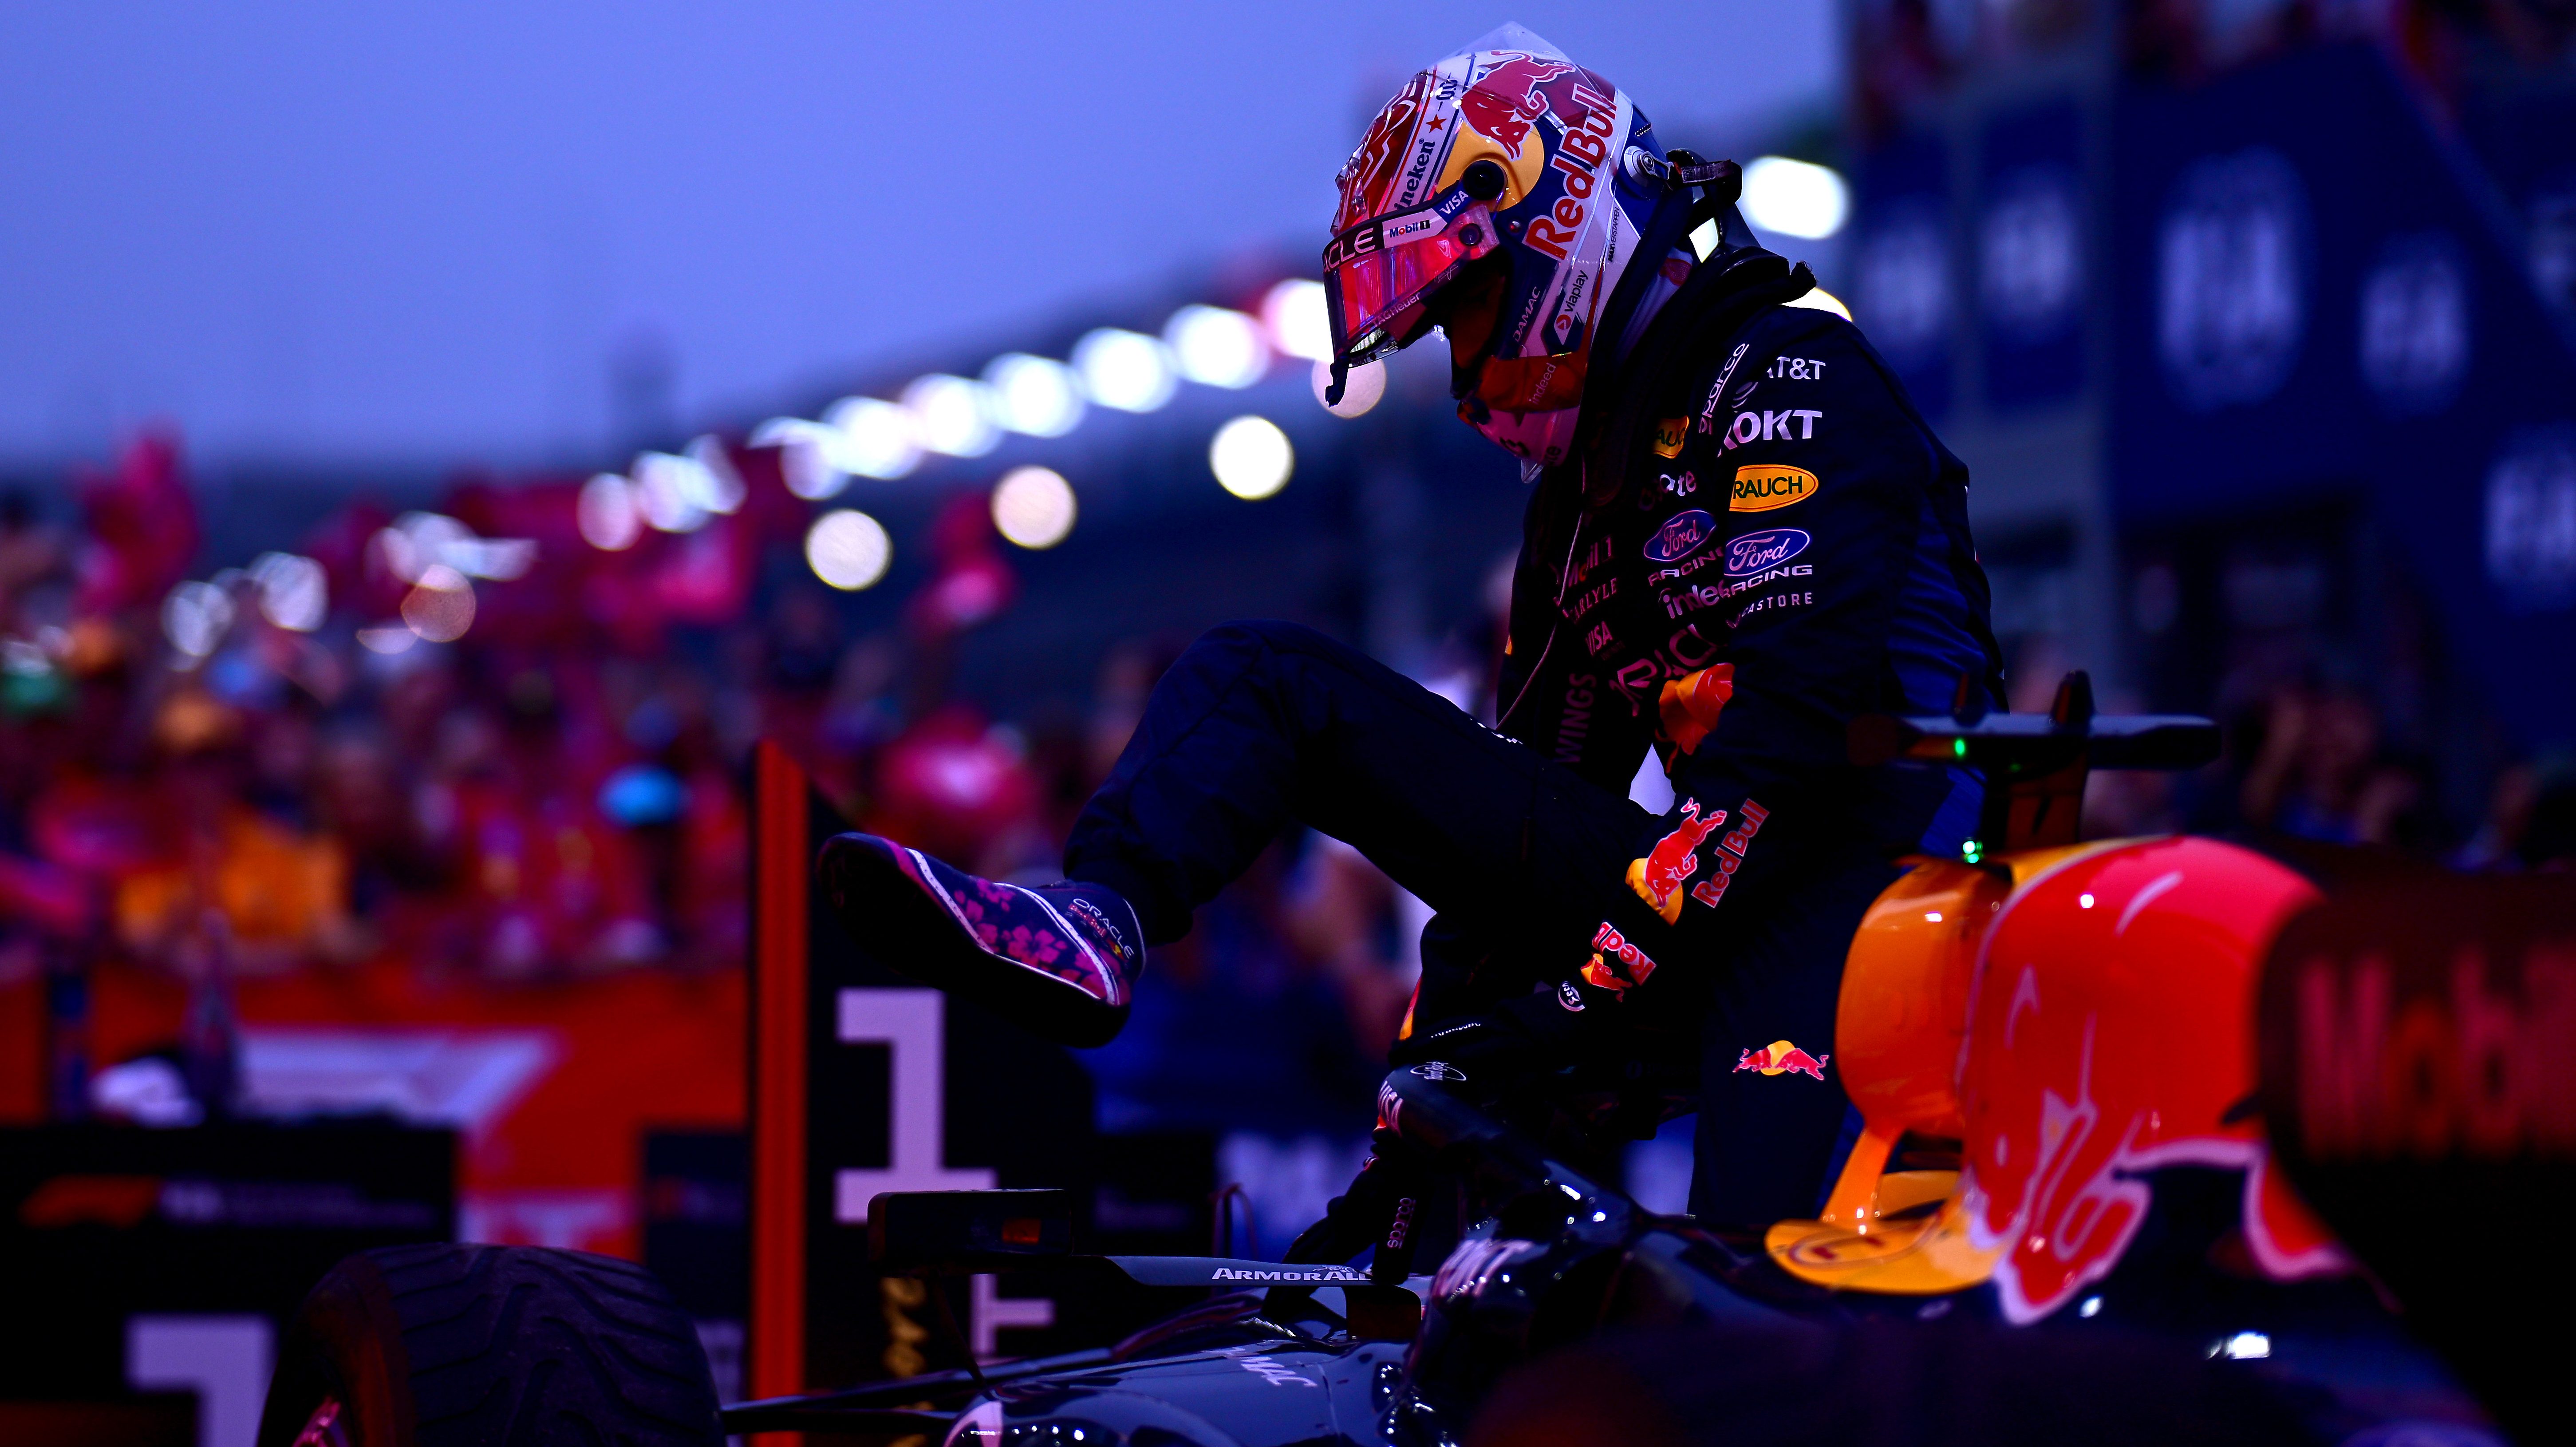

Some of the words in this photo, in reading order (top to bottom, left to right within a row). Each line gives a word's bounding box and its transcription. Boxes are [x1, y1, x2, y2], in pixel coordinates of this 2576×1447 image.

[1393, 141, 1436, 209] ineken
[1439, 190, 1468, 215] VISA
[1324, 227, 1376, 273] ACLE
[1389, 222, 1418, 238] Mobil
[1565, 270, 1589, 312] viaplay
[1512, 286, 1541, 343] DAMAC
[1528, 362, 1557, 404] indeed
[1732, 475, 1803, 499] RAUCH
[1661, 518, 1700, 557] Ford
[1729, 535, 1791, 571] Ford
[1661, 585, 1720, 619] inde
[1584, 621, 1614, 657] VISA
[1553, 672, 1598, 764] WINGS
[1073, 898, 1135, 959] ORACLE
[832, 986, 998, 1227] 1
